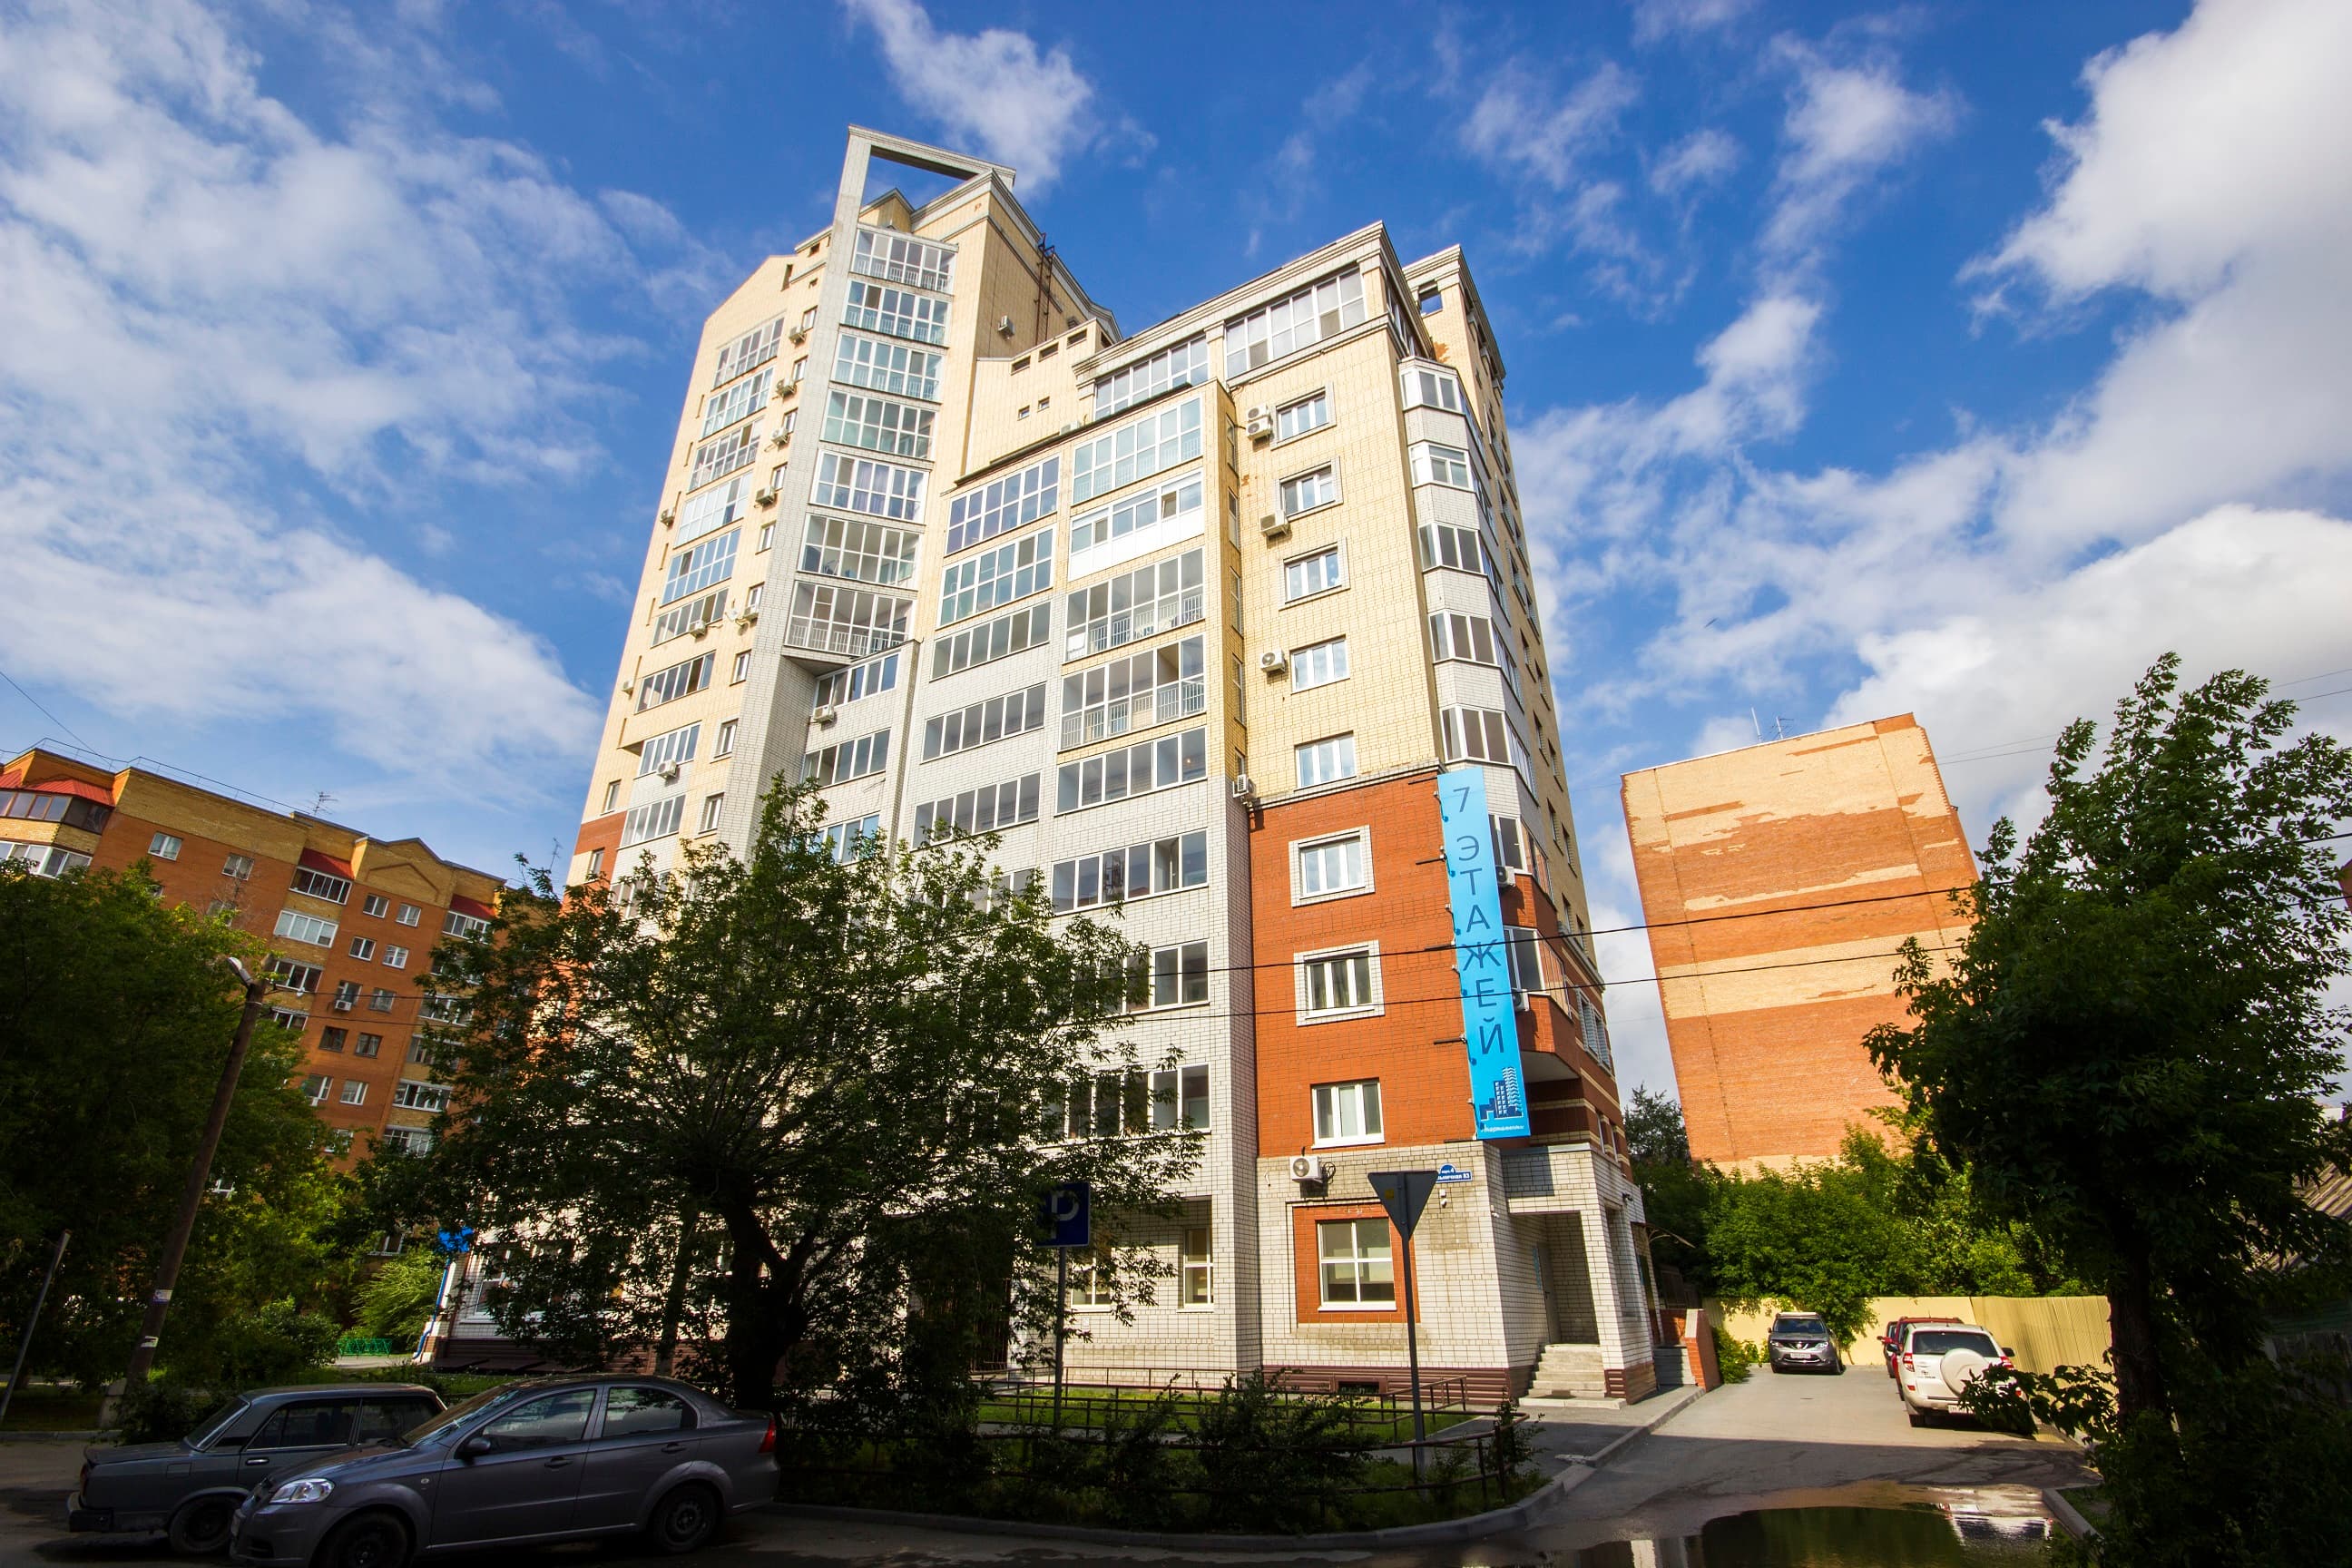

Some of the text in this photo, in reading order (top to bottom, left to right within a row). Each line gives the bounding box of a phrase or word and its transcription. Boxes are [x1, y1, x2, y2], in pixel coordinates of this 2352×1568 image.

[1453, 786, 1504, 1055] 7 ЭТАЖЕЙ
[1051, 1190, 1080, 1240] P
